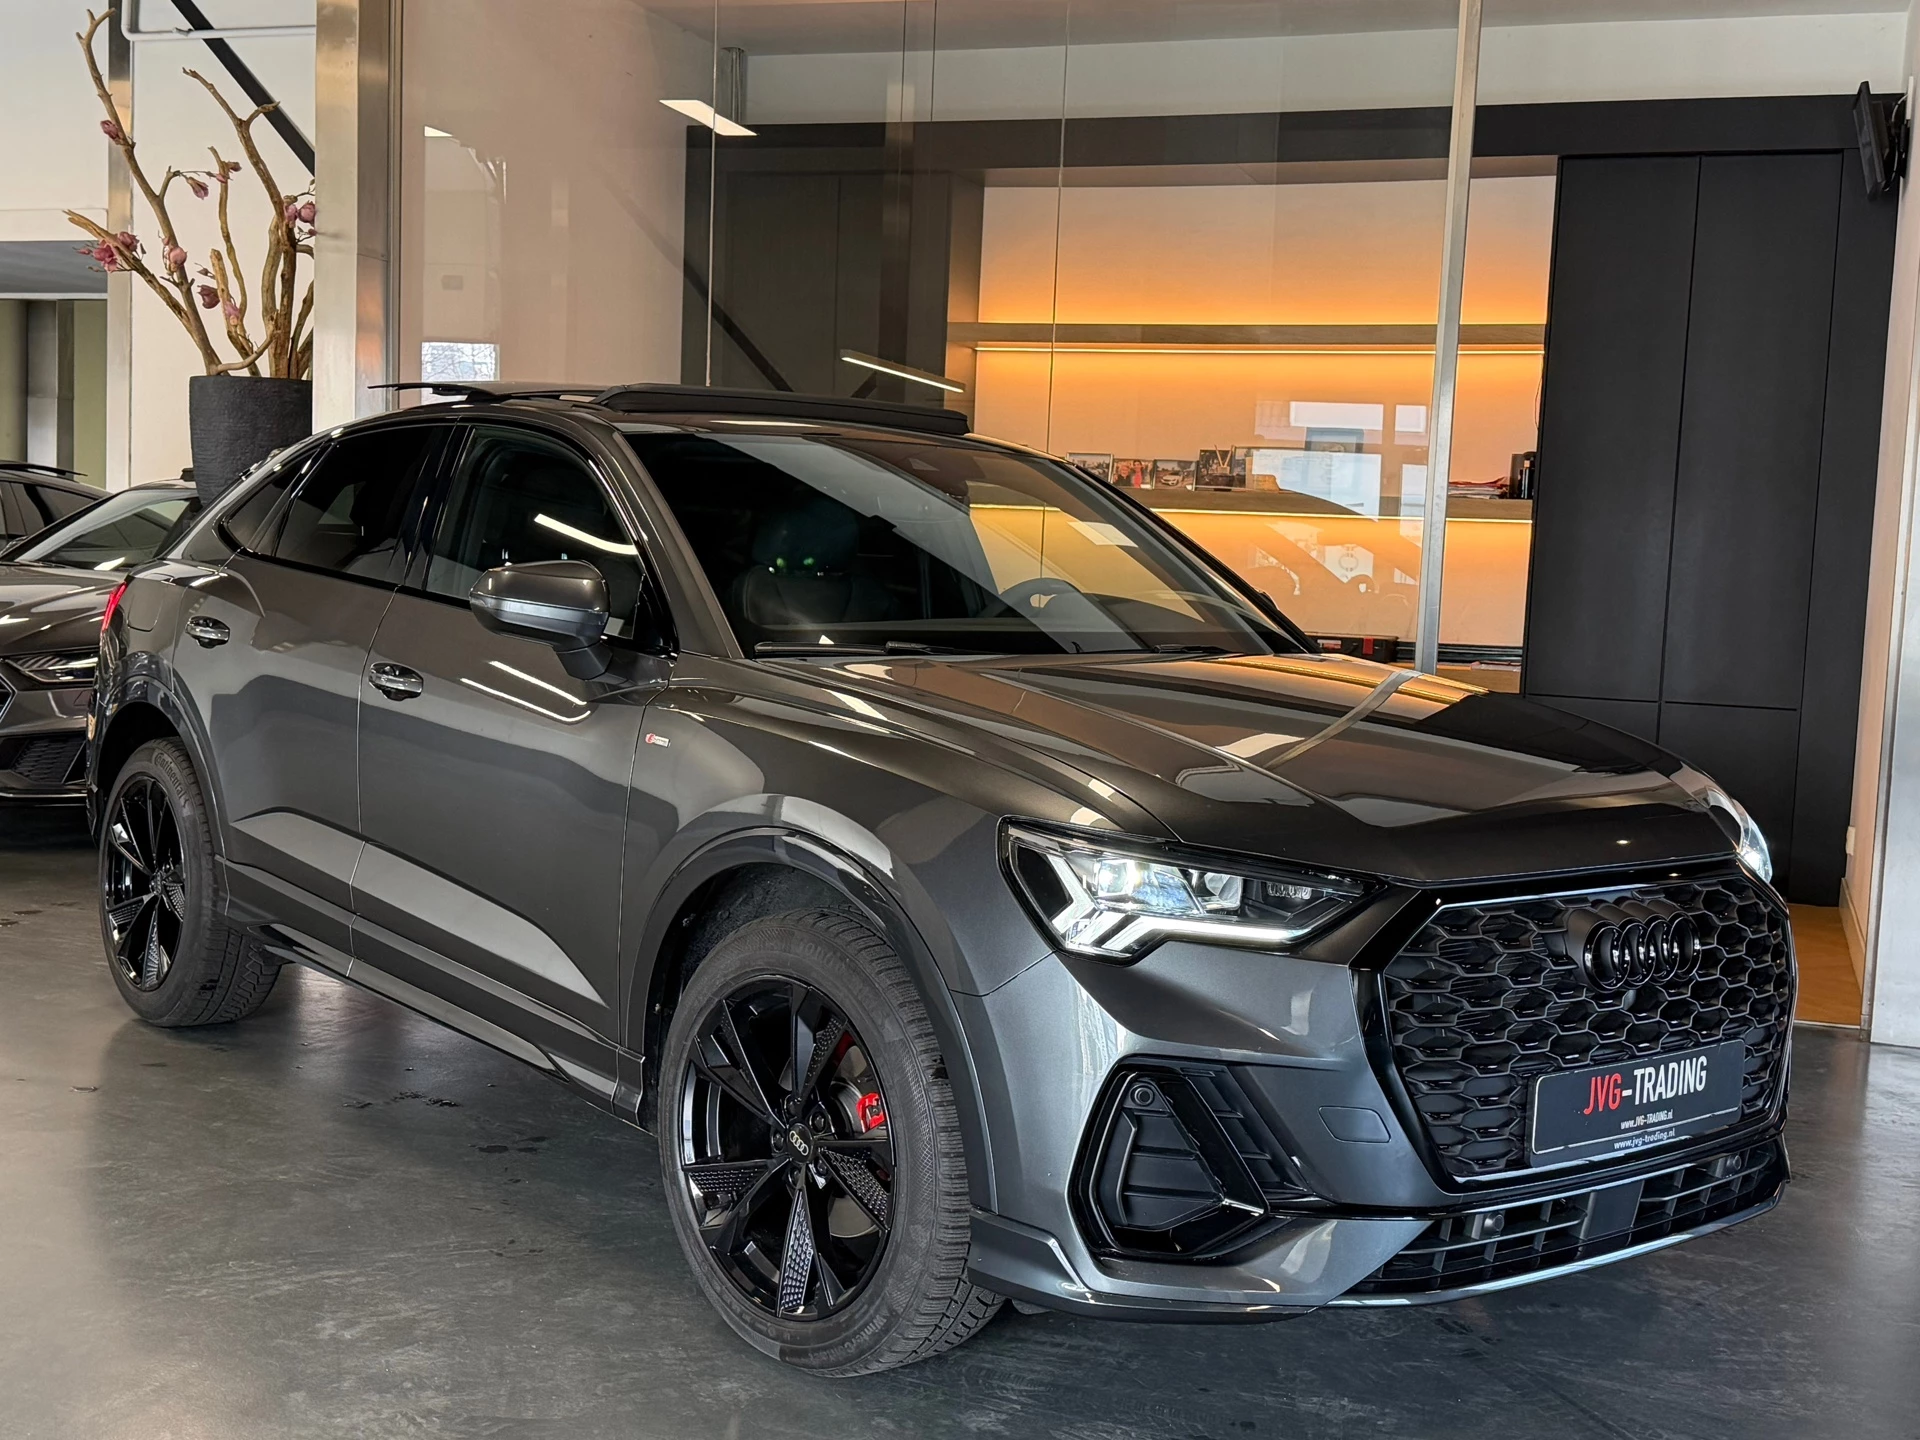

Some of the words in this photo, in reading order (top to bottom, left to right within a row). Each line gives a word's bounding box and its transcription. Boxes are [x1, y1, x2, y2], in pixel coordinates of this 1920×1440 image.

[1583, 1055, 1708, 1115] JVG-TRADING
[1620, 1109, 1674, 1130] www.JVG-TRADING.nl
[1613, 1127, 1676, 1150] www.jvg-trading.nl
